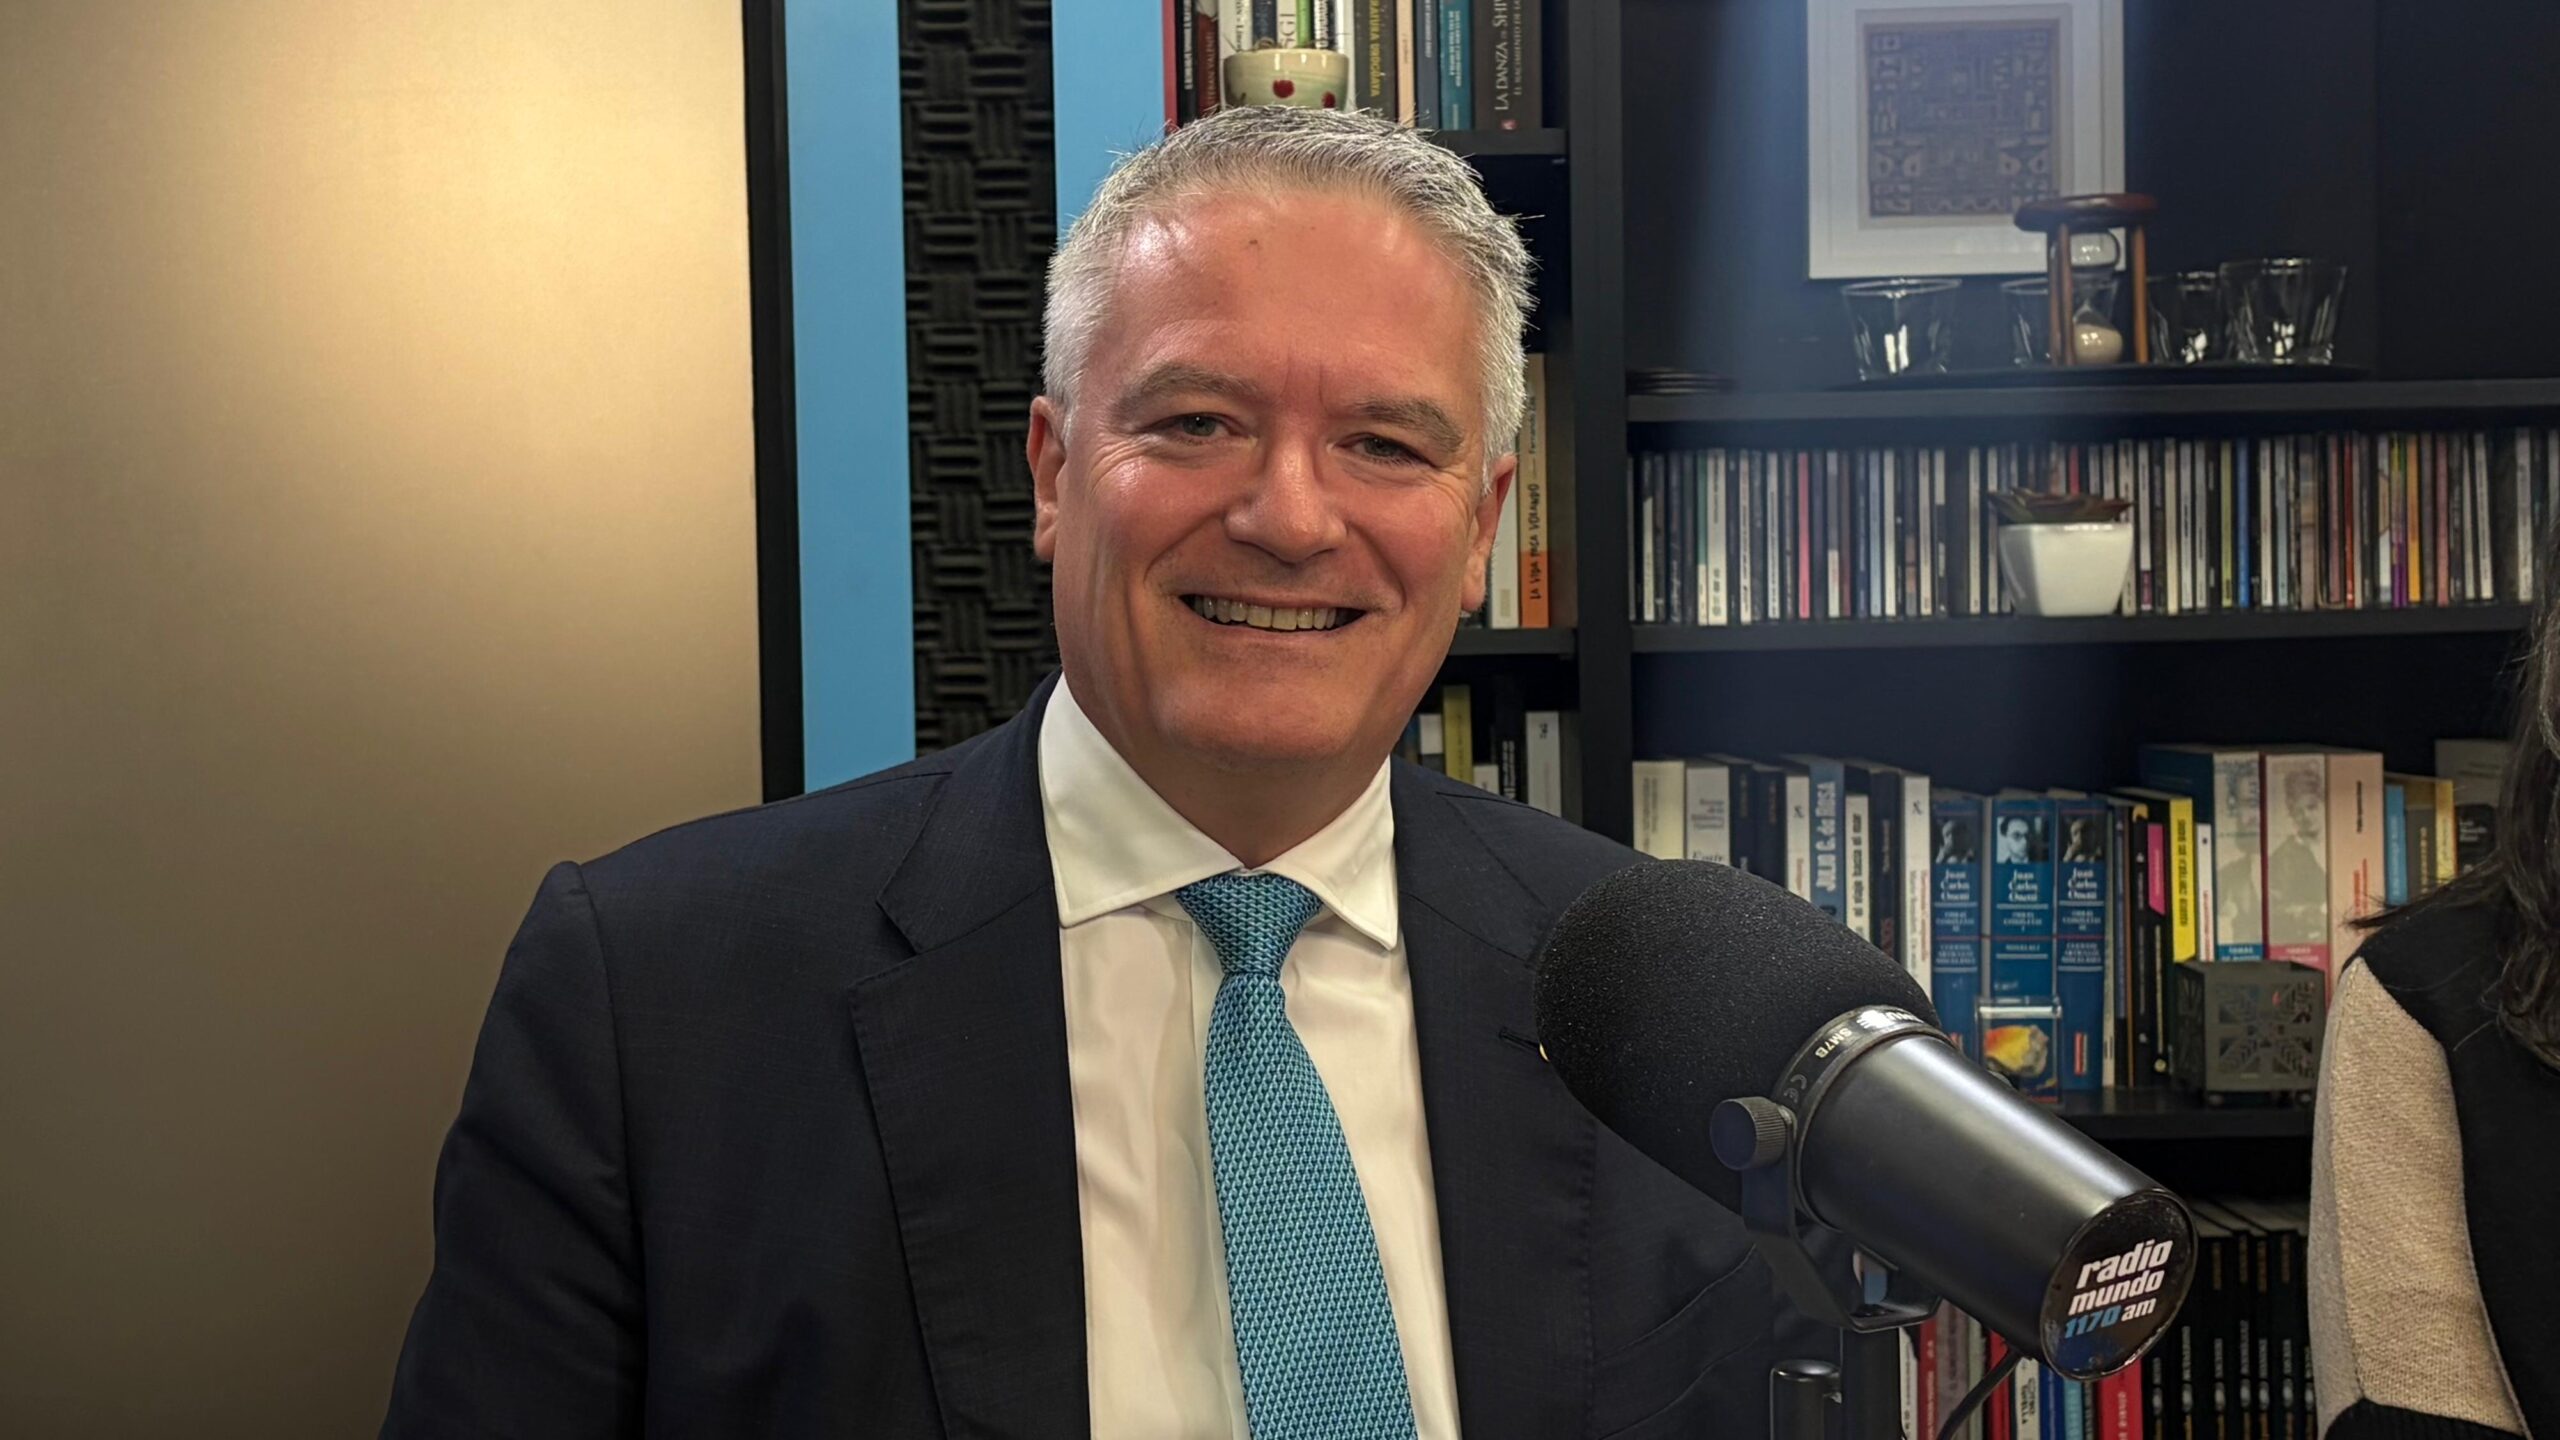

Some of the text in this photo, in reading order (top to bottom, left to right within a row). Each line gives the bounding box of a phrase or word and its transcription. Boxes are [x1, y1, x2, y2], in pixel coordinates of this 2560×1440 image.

[1494, 41, 1509, 90] DANZA
[1493, 92, 1510, 111] LA
[1527, 483, 1540, 530] VOLANDO
[1529, 561, 1542, 584] VIDA
[1530, 587, 1541, 600] LA
[1814, 780, 1837, 817] ROSA
[1815, 838, 1836, 851] C.
[1815, 853, 1837, 892] JULIO
[1945, 870, 1966, 880] Juan
[2013, 869, 2034, 880] Juan
[2072, 867, 2094, 879] Juan
[1940, 880, 1970, 891] Carlos
[2008, 881, 2038, 892] Carlos
[2067, 879, 2098, 890] Carlos
[1940, 891, 1970, 902] Onetti
[2008, 891, 2038, 902] Onetti
[2067, 890, 2098, 901] Onetti
[1814, 1027, 1853, 1059] SM7B
[2075, 1238, 2174, 1290] radio
[2067, 1269, 2166, 1317] mundo
[2064, 1297, 2158, 1340] 1170 am
